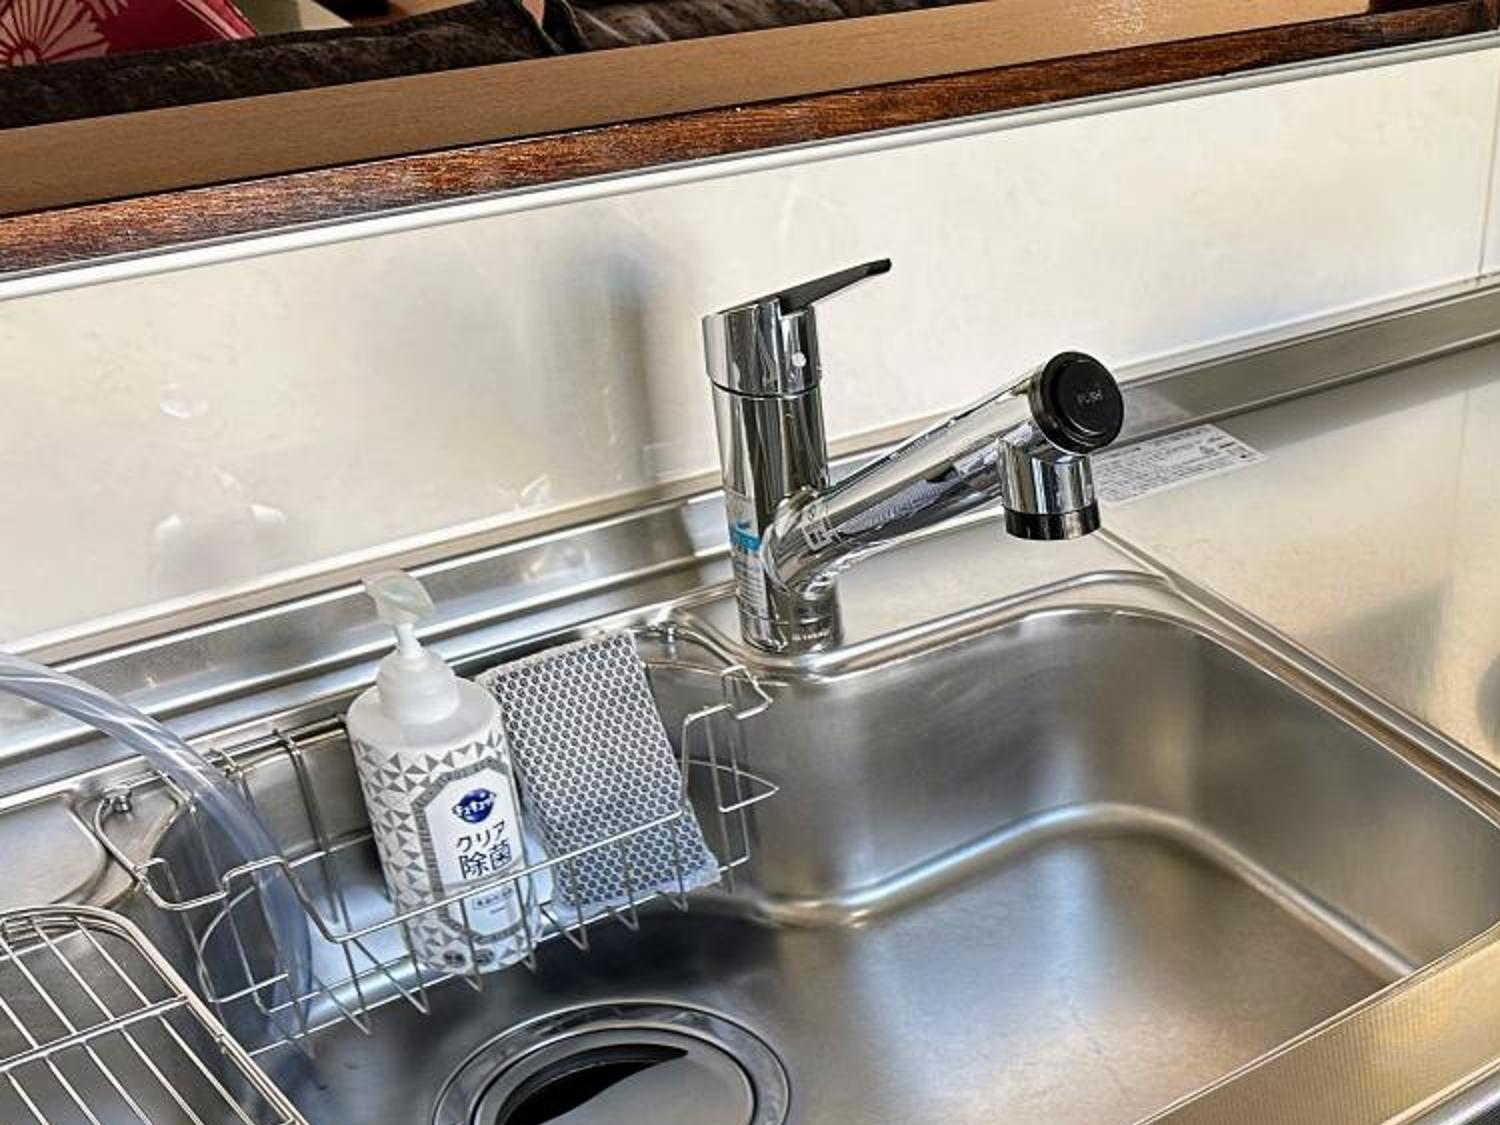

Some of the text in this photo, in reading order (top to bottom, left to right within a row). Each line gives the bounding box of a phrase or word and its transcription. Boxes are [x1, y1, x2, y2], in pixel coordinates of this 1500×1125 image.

[456, 819, 505, 853] クリア
[458, 839, 513, 879] 除菌
